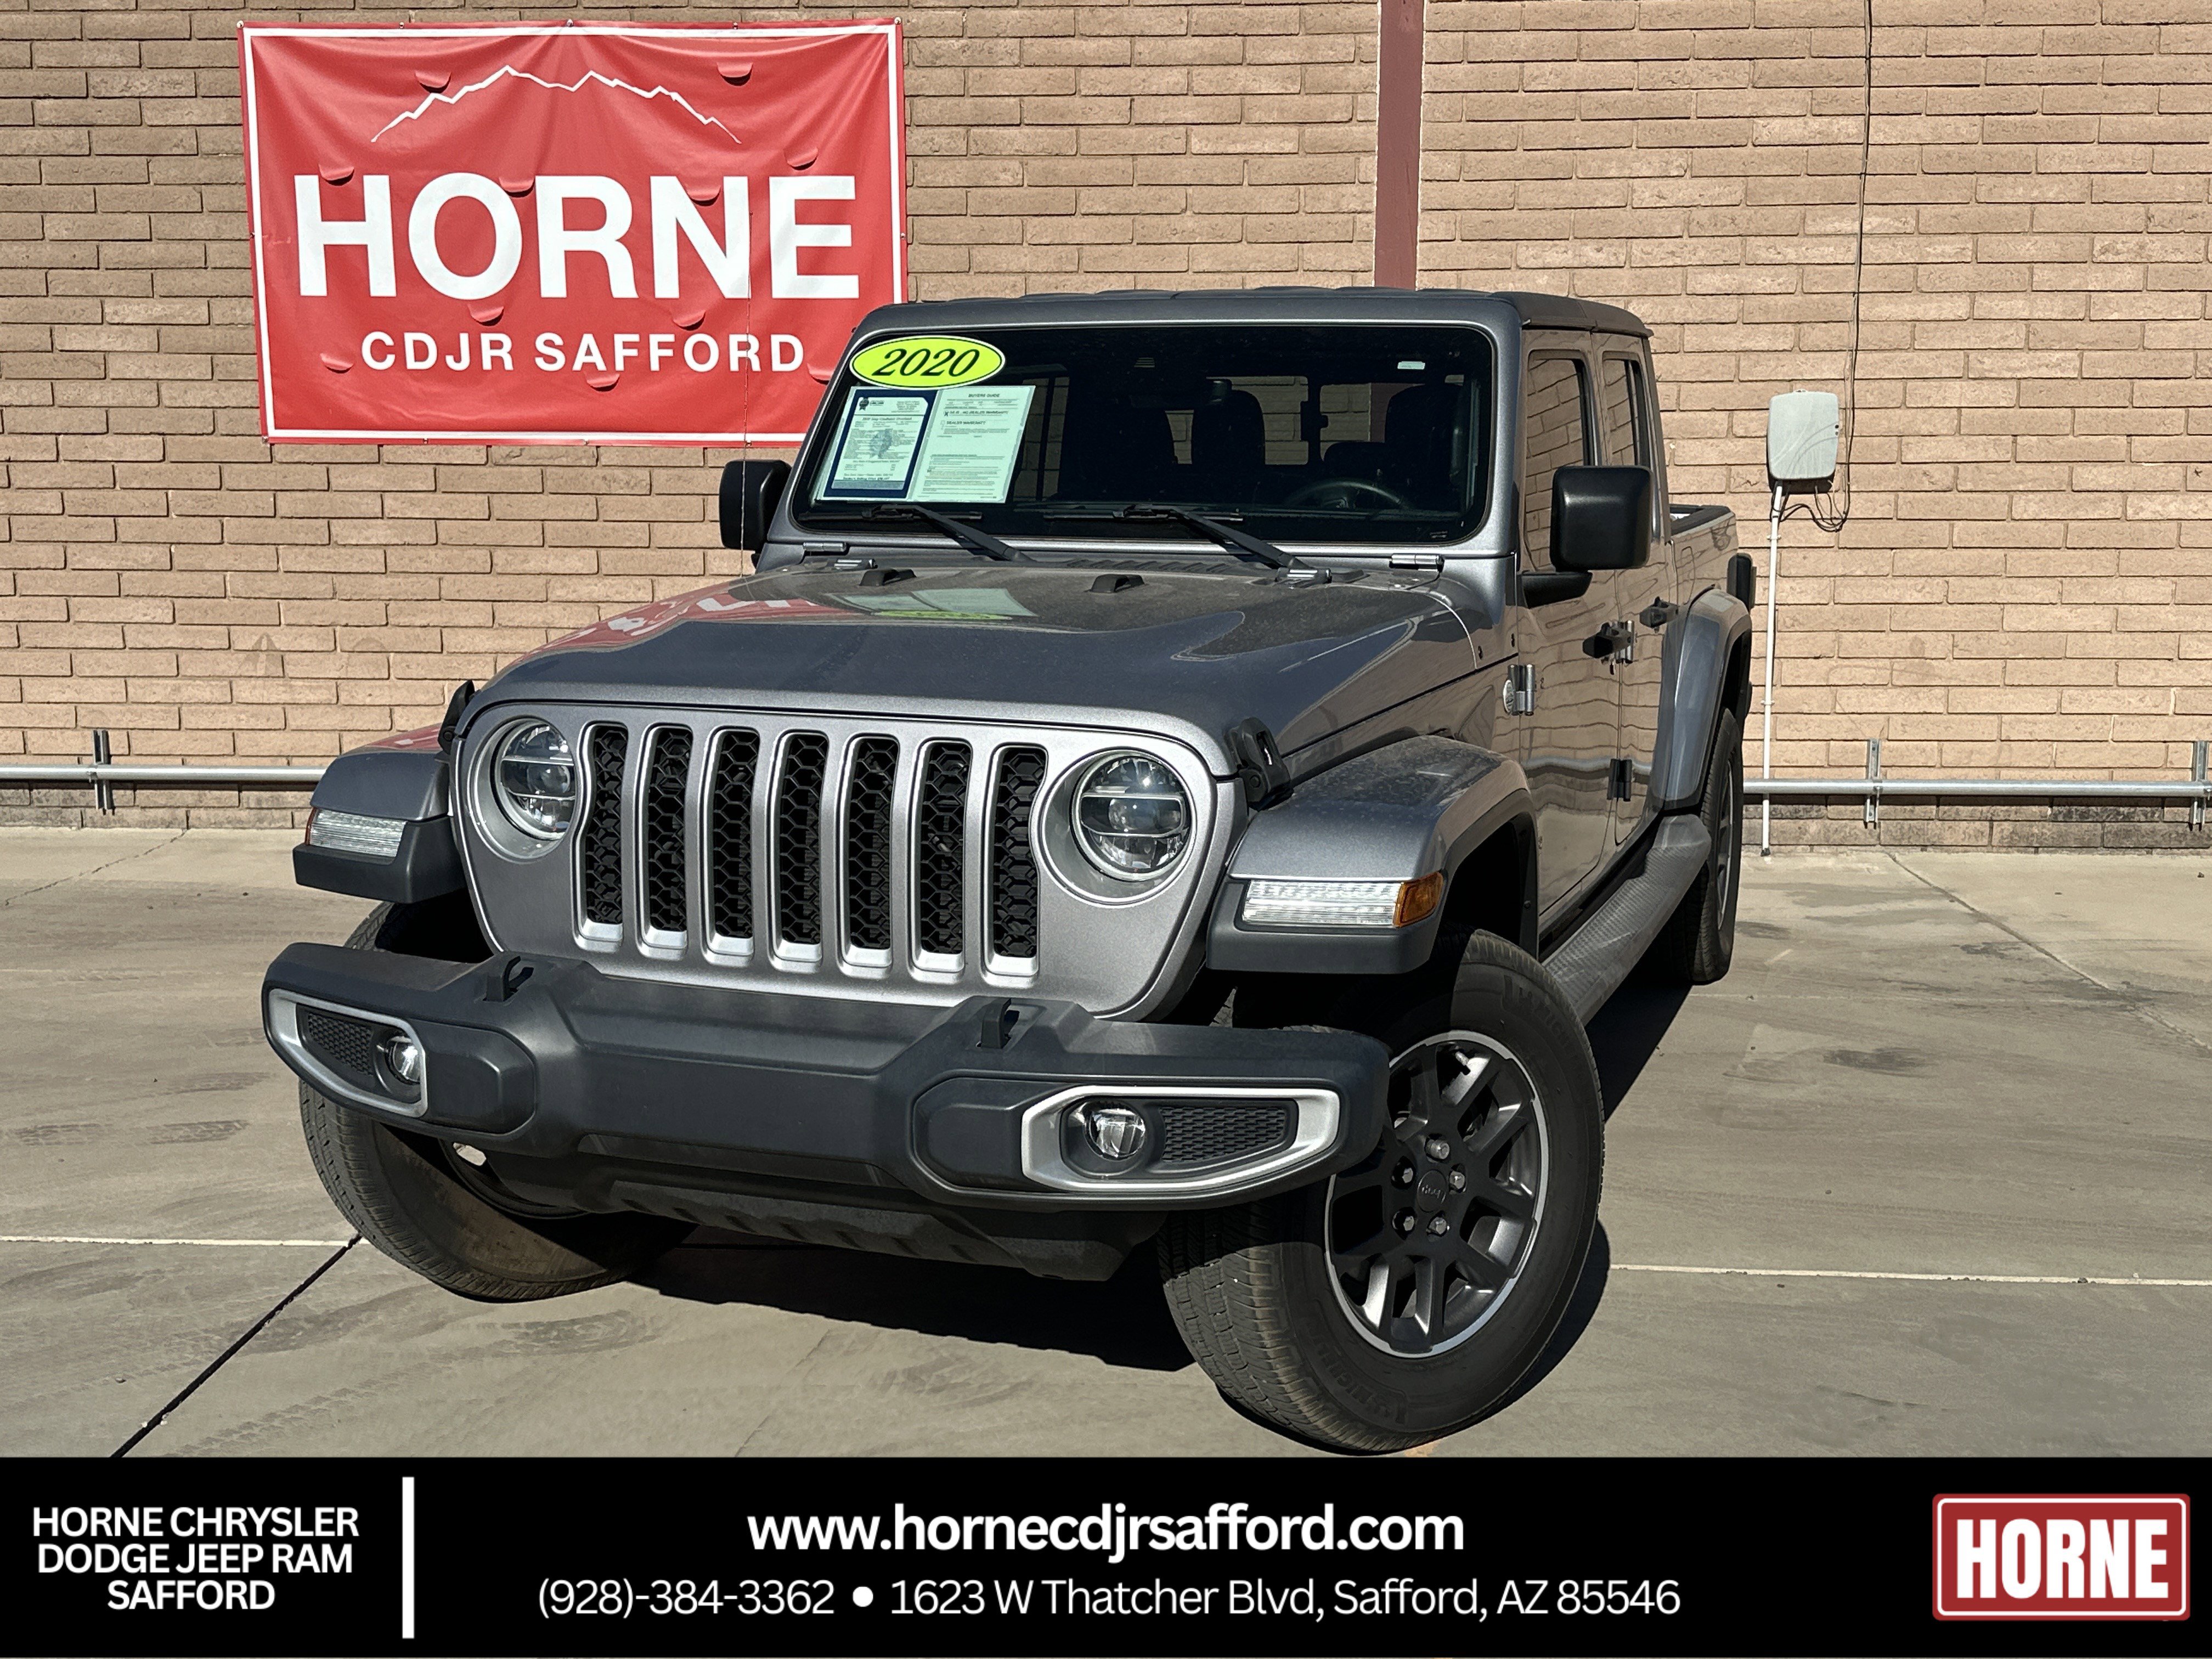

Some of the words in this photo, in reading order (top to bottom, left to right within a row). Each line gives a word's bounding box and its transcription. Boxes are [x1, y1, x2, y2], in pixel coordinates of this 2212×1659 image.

[295, 173, 859, 300] HORNE
[362, 331, 513, 371] CDJR
[535, 332, 803, 372] SAFFORD
[872, 349, 979, 376] 2020
